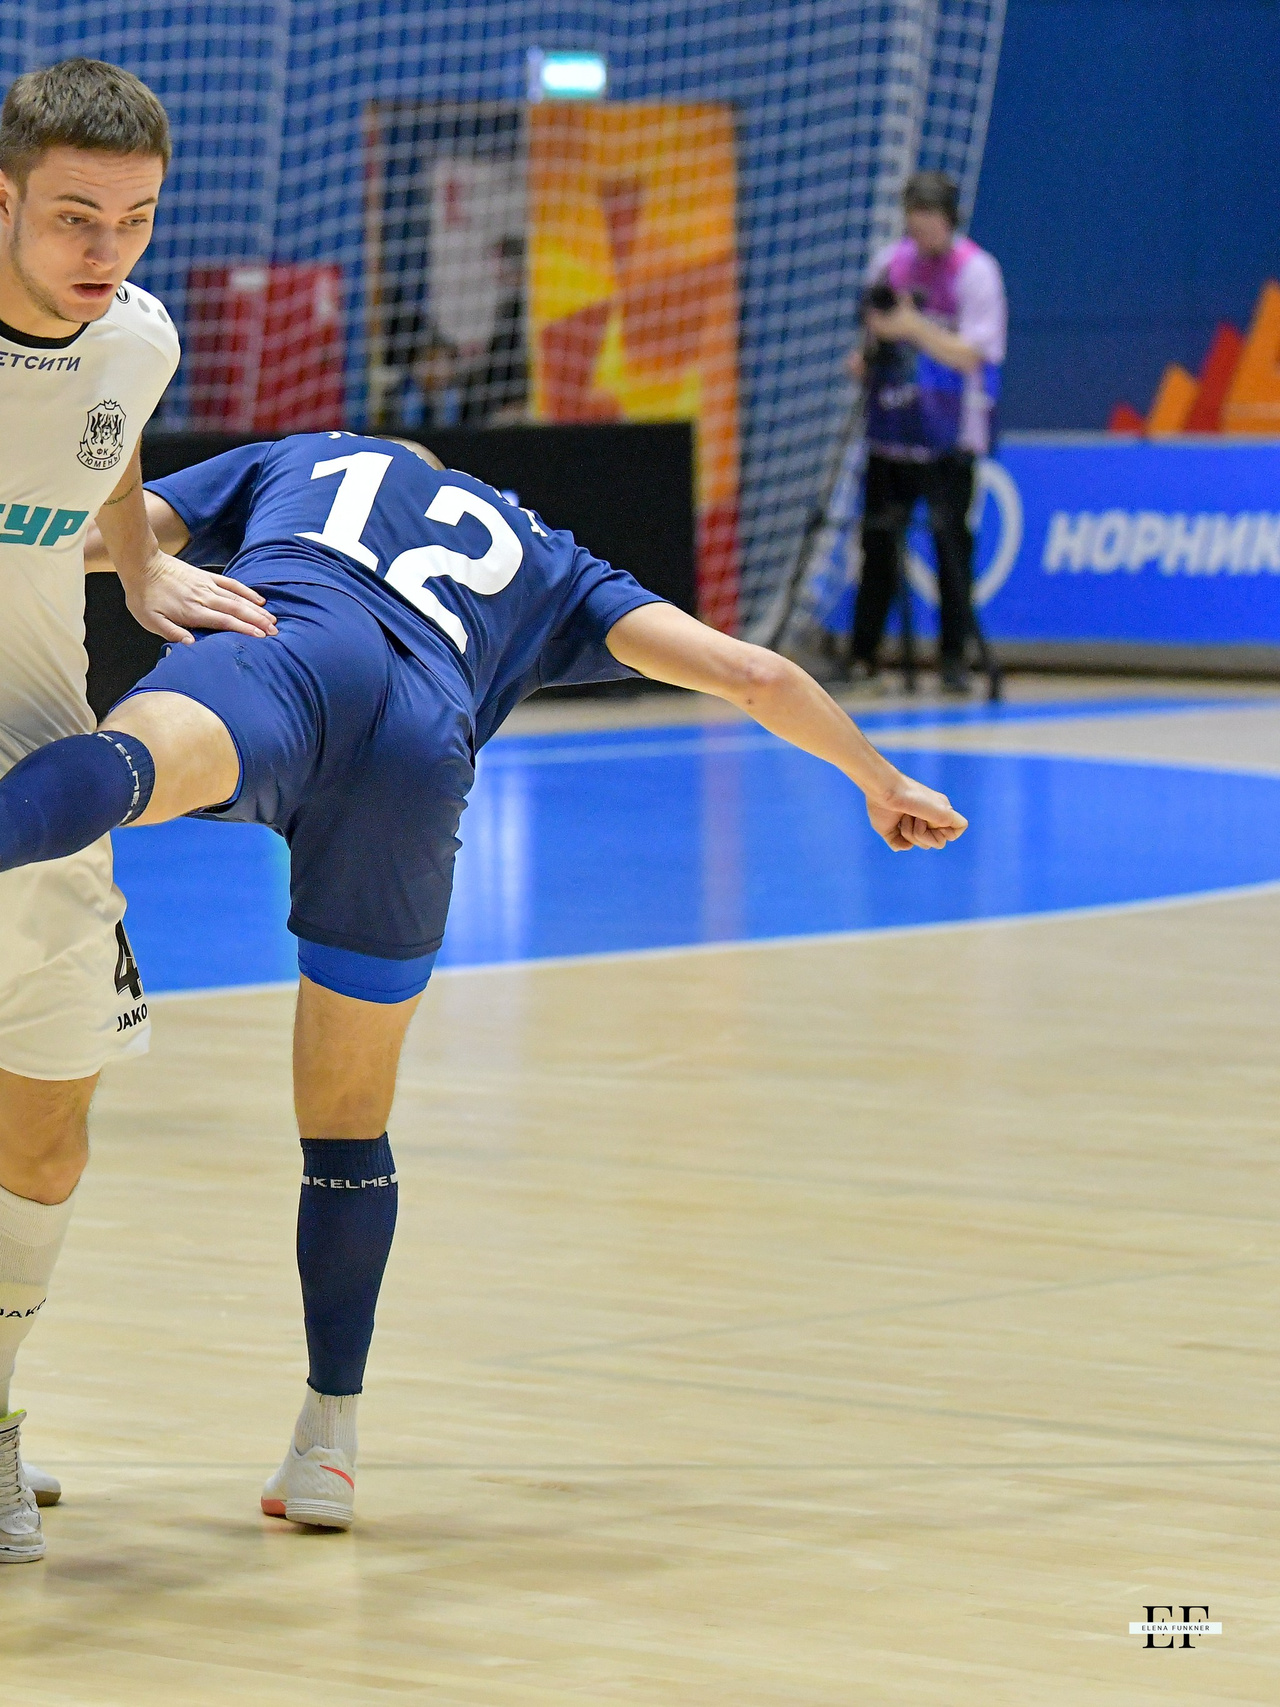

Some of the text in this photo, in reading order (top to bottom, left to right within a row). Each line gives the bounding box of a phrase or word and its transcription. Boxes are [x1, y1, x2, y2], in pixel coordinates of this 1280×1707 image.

[81, 452, 118, 468] ТЮМЕНЬ
[293, 451, 524, 655] 12
[116, 1003, 148, 1032] JAKO
[313, 1176, 389, 1189] KELME
